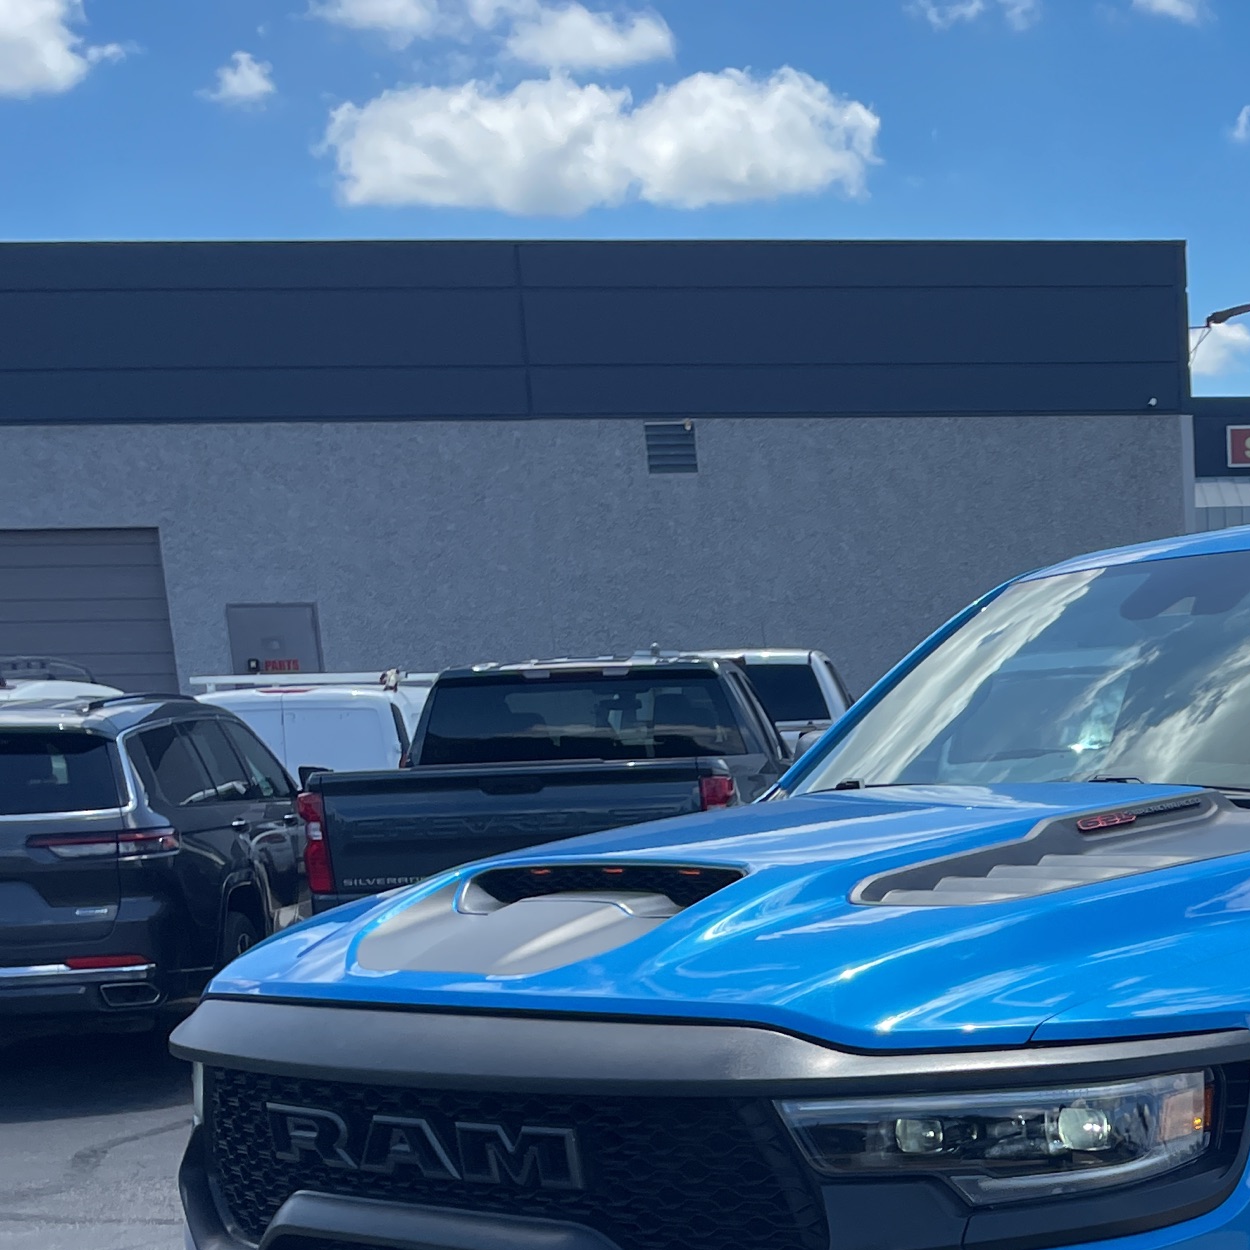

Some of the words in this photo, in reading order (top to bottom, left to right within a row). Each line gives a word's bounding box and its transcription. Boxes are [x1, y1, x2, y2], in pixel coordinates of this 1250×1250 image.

[264, 659, 300, 671] PARTS
[343, 876, 424, 886] SILVERAD
[266, 1101, 584, 1191] RAM
